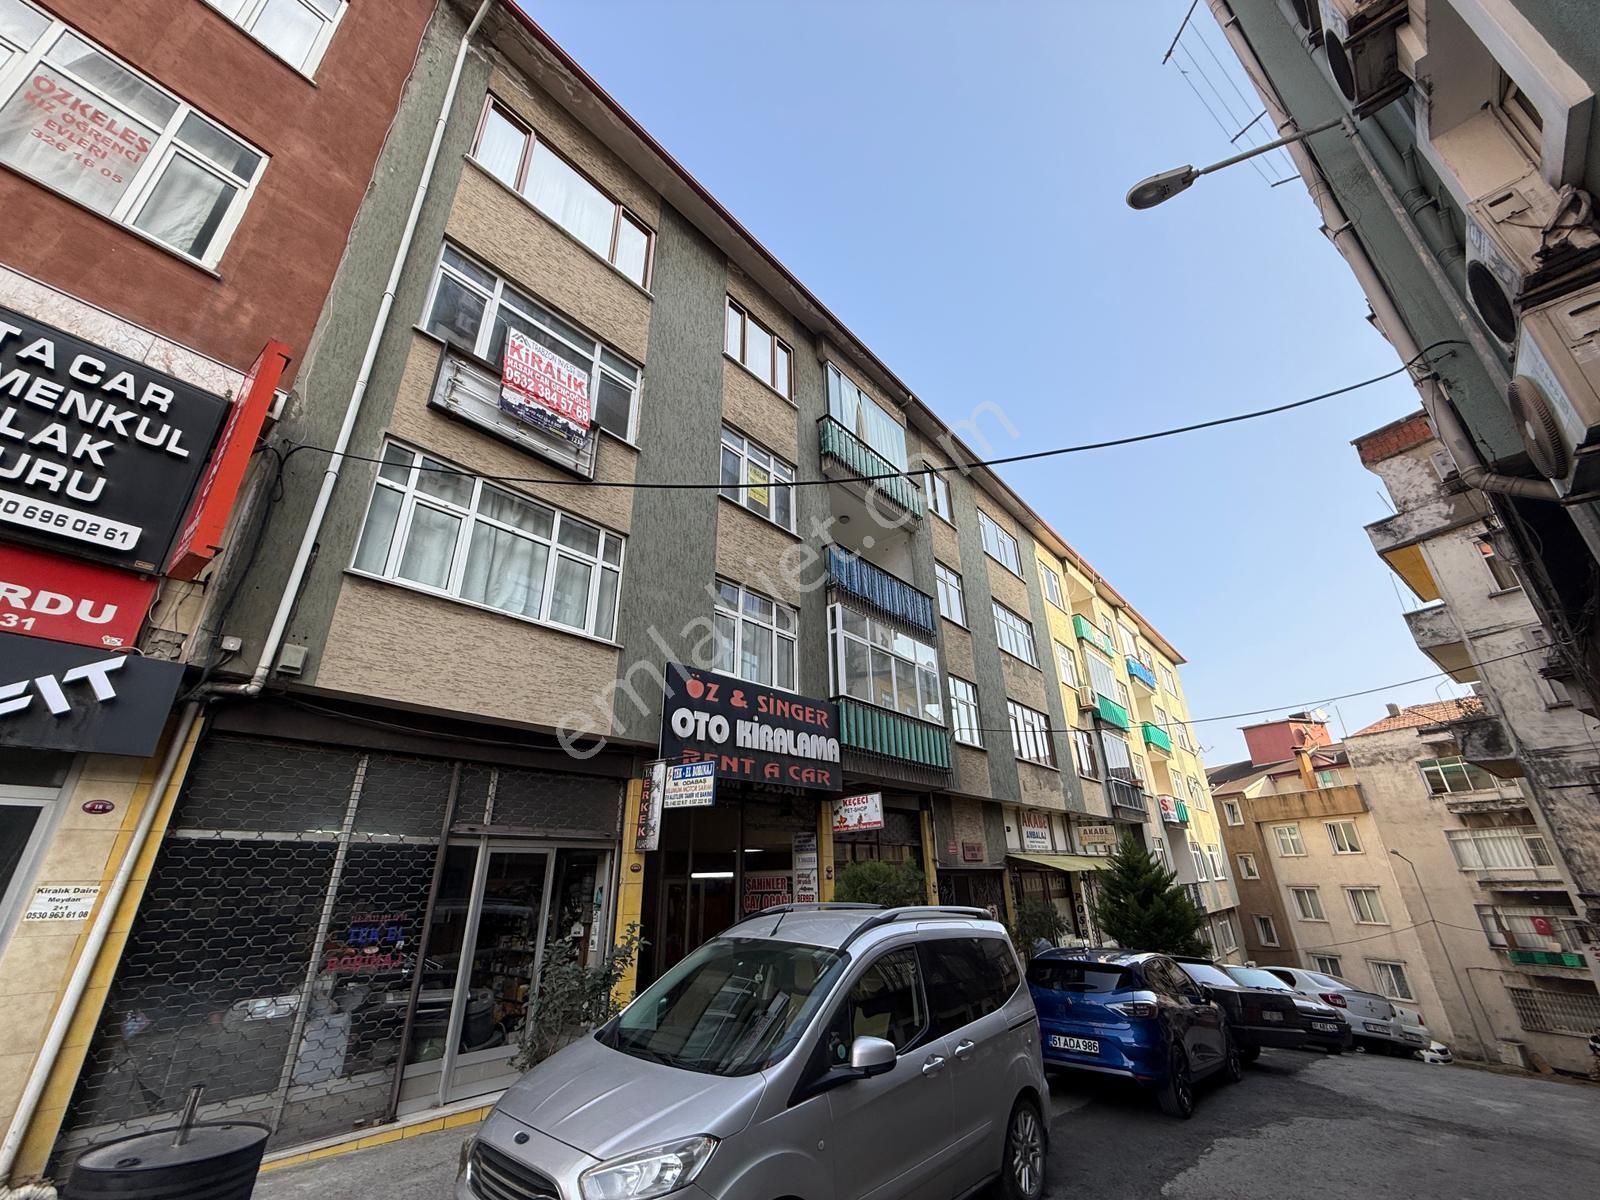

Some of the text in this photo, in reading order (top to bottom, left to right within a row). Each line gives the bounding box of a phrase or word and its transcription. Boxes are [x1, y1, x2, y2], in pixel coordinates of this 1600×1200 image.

[31, 128, 123, 183] 326 16 05
[16, 337, 55, 369] A
[69, 354, 175, 414] CAR
[505, 368, 534, 391] 0532
[538, 383, 558, 405] 384
[561, 396, 573, 412] 57
[576, 405, 589, 421] 68
[23, 504, 67, 528] 696
[72, 519, 100, 539] 02
[103, 527, 130, 545] 61
[686, 673, 829, 728] ÖZ & SİNGER
[671, 708, 840, 762] OTO KİRALAMA
[764, 763, 781, 778] A
[789, 766, 831, 786] CAR
[36, 887, 99, 895] Kiralık Daire
[48, 896, 81, 904] Meydan
[26, 911, 88, 919] 0530 963 61 08
[1064, 1038, 1081, 1050] ADA
[1082, 1040, 1098, 1052] 986
